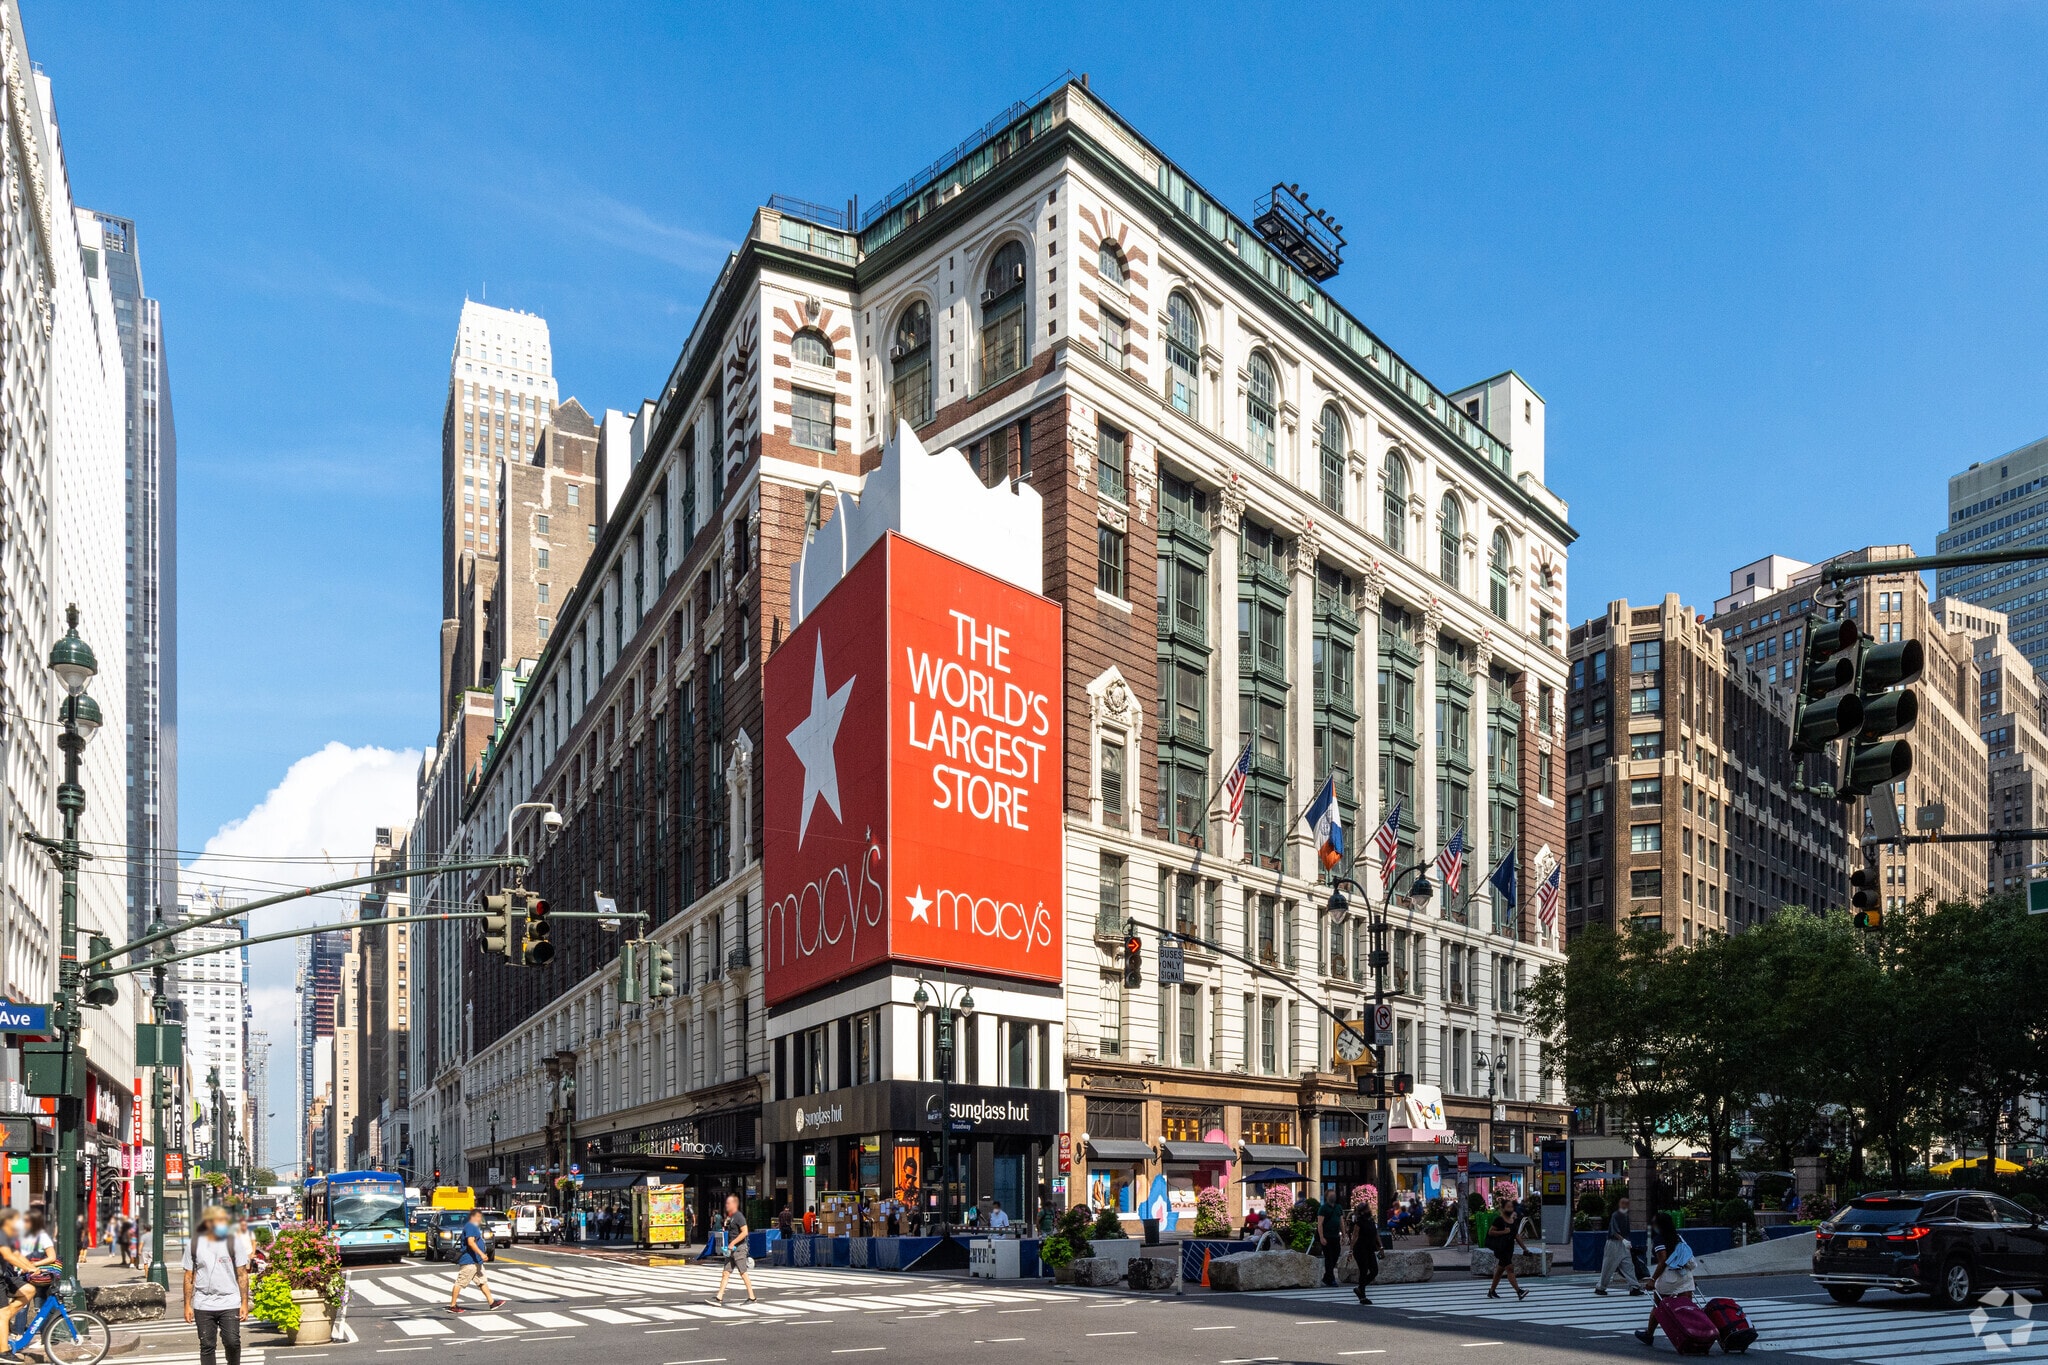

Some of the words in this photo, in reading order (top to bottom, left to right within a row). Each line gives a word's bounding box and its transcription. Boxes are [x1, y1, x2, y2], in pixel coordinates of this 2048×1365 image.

[948, 608, 1011, 675] THE
[906, 646, 1050, 737] WORLD'S
[908, 700, 1046, 785] LARGEST
[932, 763, 1030, 832] STORE
[767, 824, 884, 972] macy's
[936, 886, 1052, 954] macy's
[1160, 950, 1183, 960] BUSES
[1162, 961, 1181, 970] ONLY
[1160, 971, 1182, 981] SIGNAL
[0, 1010, 31, 1026] Ave
[10, 1081, 18, 1112] verizon
[174, 1104, 182, 1131] KAY
[805, 1105, 831, 1130] sunglass
[831, 1103, 843, 1123] hut
[949, 1098, 1006, 1125] sunglass
[1008, 1100, 1030, 1122] hut
[1370, 1113, 1386, 1121] KEEP
[682, 1142, 724, 1157] macy's
